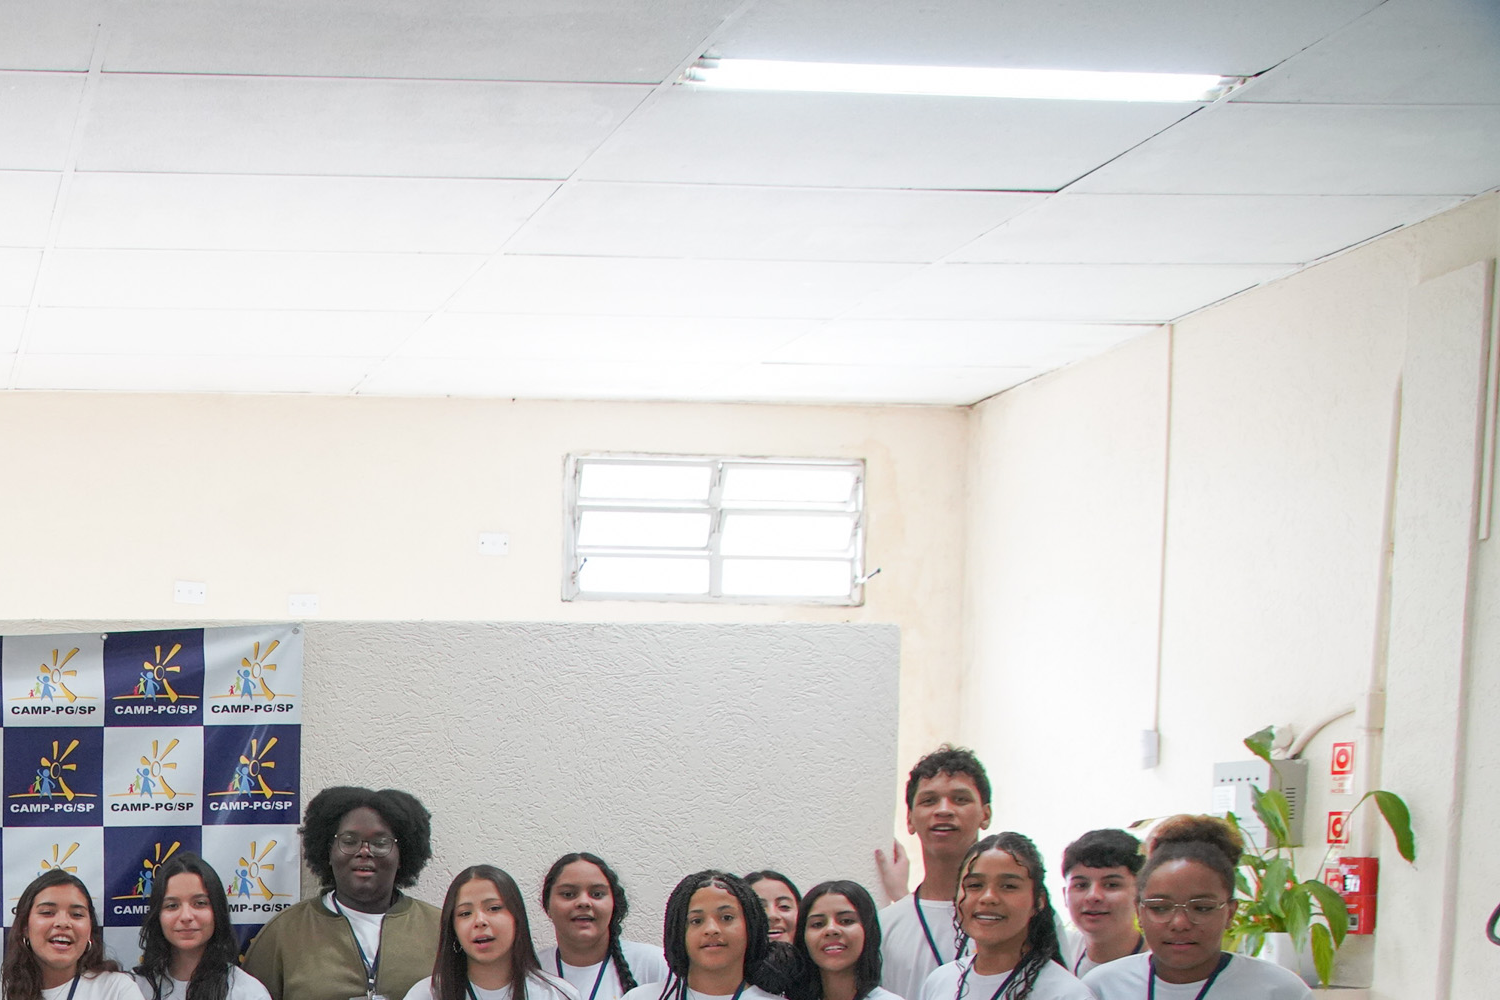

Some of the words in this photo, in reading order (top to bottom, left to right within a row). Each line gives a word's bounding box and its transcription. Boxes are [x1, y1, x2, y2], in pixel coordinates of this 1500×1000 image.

[11, 704, 97, 716] CAMP-PG/SP
[114, 704, 198, 715] CAMP-PG/SP
[210, 703, 294, 714] CAMP-PG/SP
[10, 802, 95, 813] CAMP-PG/SP
[110, 801, 194, 813] CAMP-PG/SP
[209, 800, 293, 811] CAMP-PG/SP
